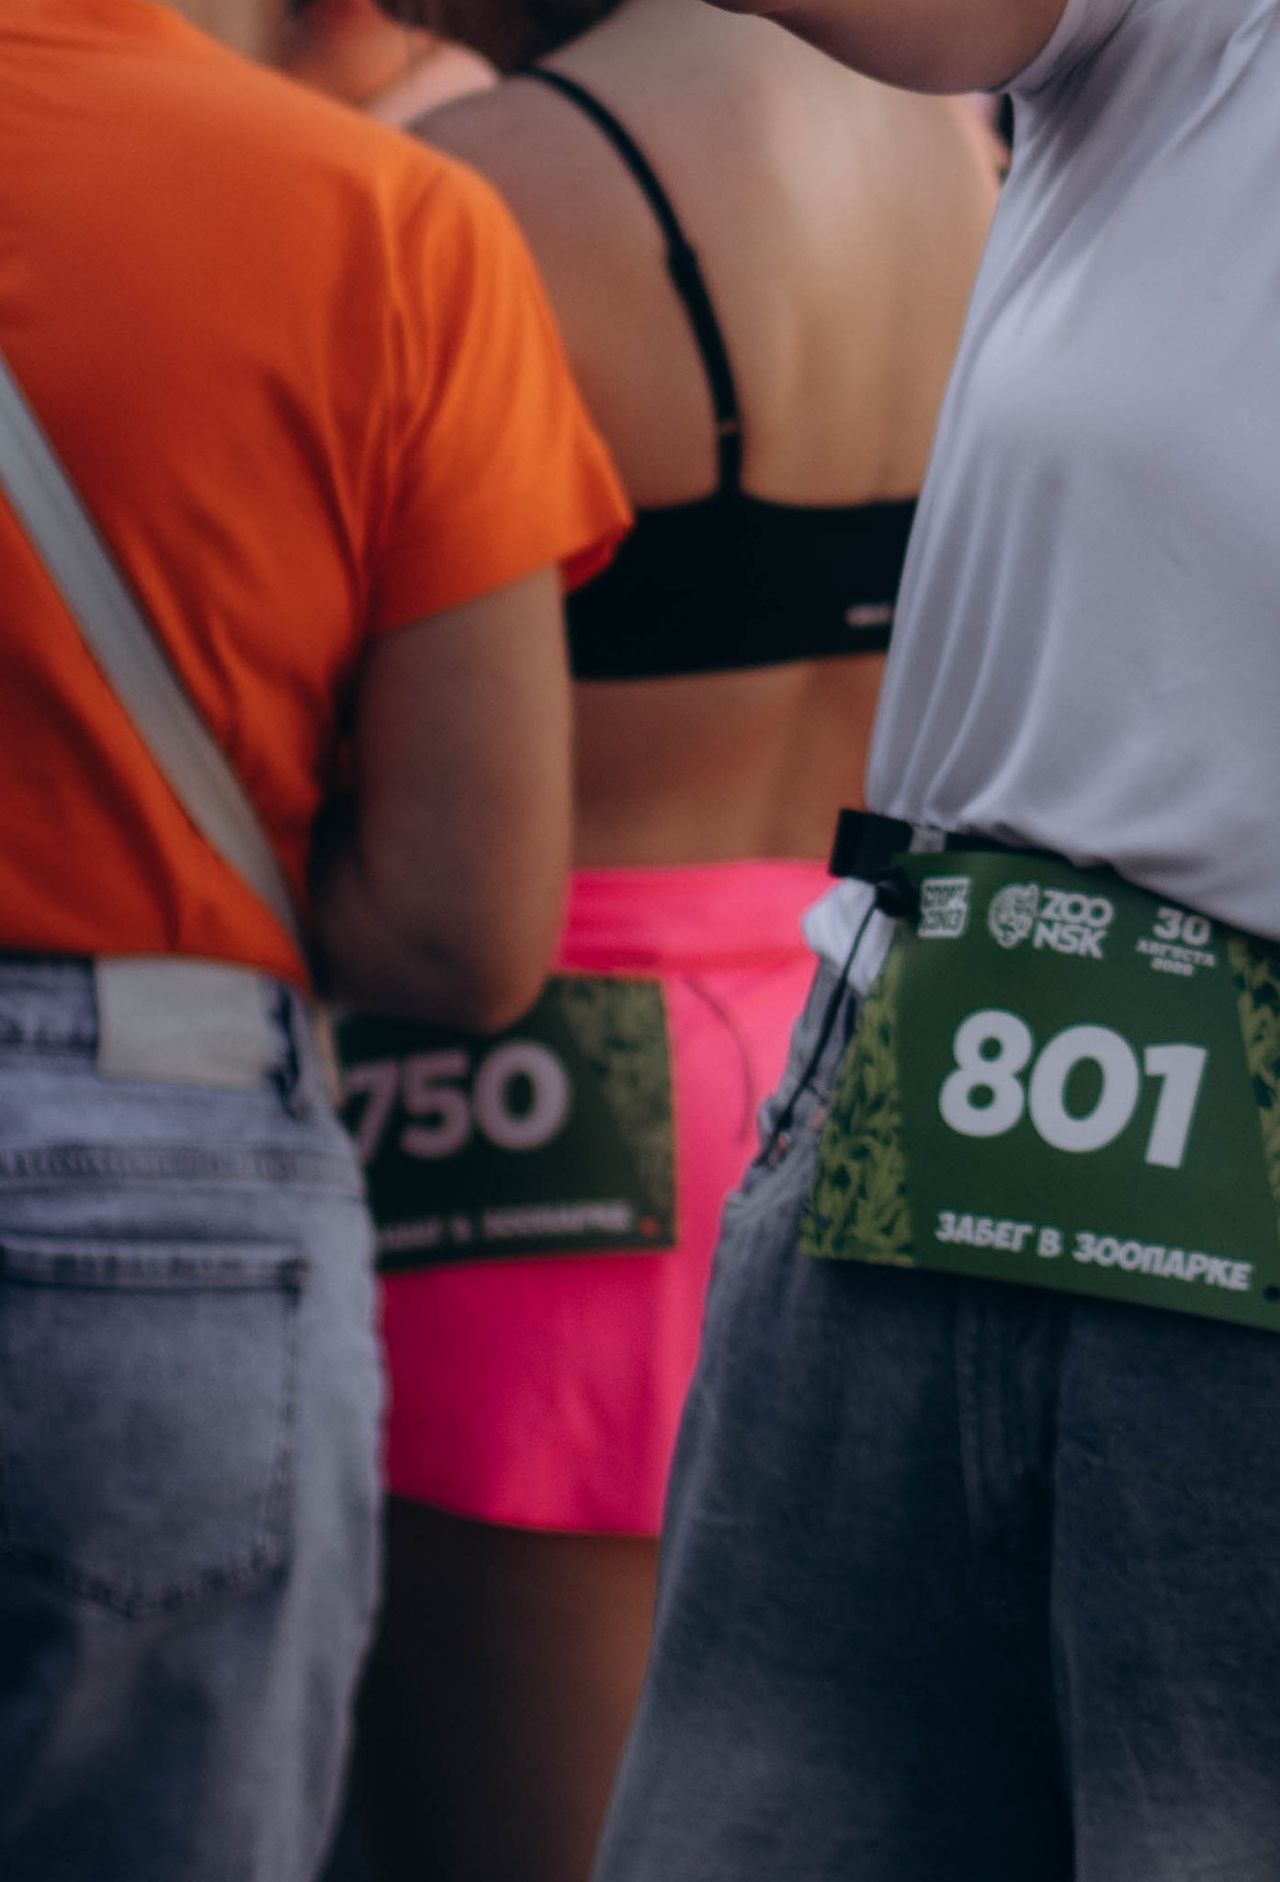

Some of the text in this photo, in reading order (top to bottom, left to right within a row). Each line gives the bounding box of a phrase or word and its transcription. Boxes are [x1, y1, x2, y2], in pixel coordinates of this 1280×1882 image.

[1040, 889, 1115, 929] ZOO
[1152, 906, 1212, 947] 30
[1032, 921, 1108, 960] NSK
[345, 1040, 569, 1162] 750
[938, 1009, 1208, 1170] 801
[934, 1210, 1253, 1292] ЗАБЕГ В ЗООПАРКЕ
